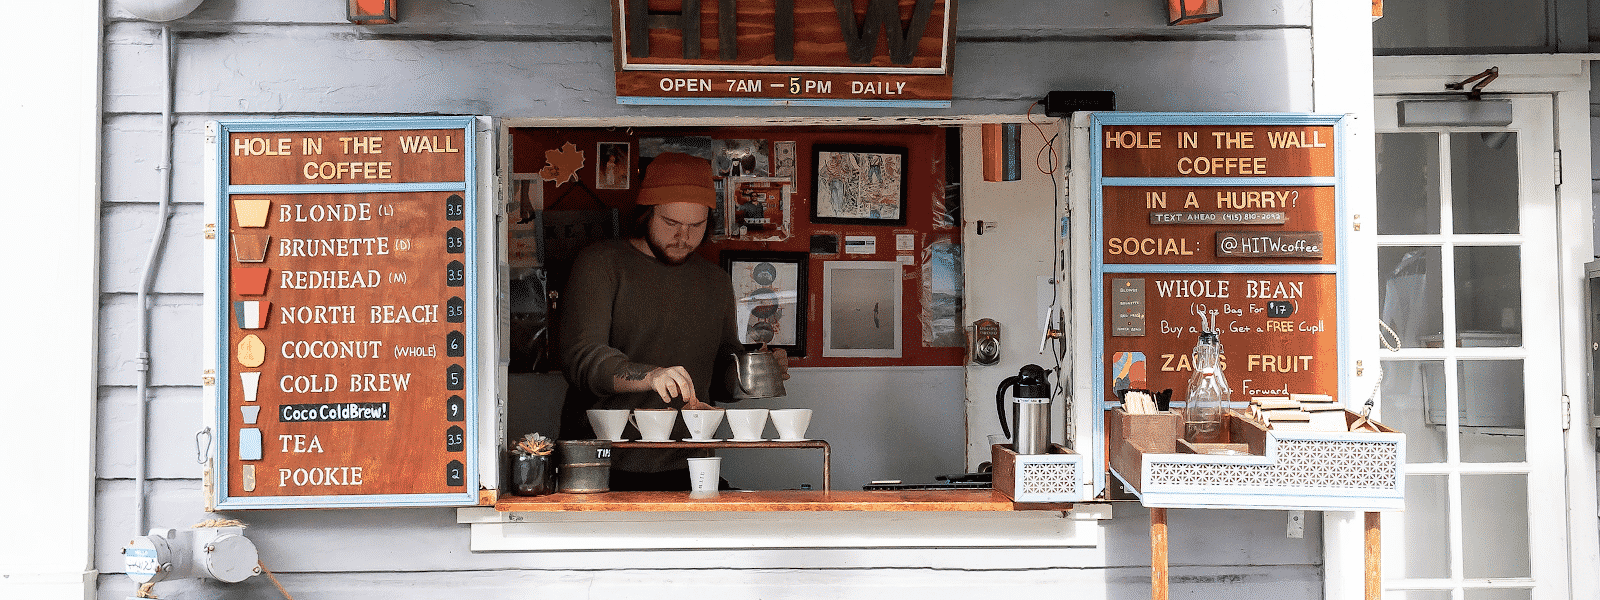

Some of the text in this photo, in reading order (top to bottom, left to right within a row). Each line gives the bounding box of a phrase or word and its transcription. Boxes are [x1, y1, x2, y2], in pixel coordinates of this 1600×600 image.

[659, 77, 712, 93] OPEN
[726, 79, 762, 93] 7AM
[851, 81, 907, 95] DAILY
[234, 135, 459, 156] HOLE IN THE WALL
[1105, 130, 1327, 149] HOLE IN THE WALL
[303, 161, 392, 180] COFFEE
[1177, 156, 1267, 175] COFFEE
[1146, 190, 1299, 209] IN A HURRY?
[279, 203, 394, 222] BLONDE (L)
[447, 203, 462, 216] 3.5
[1155, 213, 1182, 222] TEXT
[1187, 213, 1216, 221] AHEAD
[278, 236, 411, 257] BRUNETTE (D)
[447, 236, 463, 248] 3.5
[280, 269, 407, 290] REDHEAD (M)
[447, 269, 463, 281] 3.5
[1155, 280, 1304, 299] WHOLE BEAN
[280, 304, 439, 325] NORTH BEACH
[448, 305, 463, 317] 3.5
[1223, 303, 1243, 317] Bag
[1249, 304, 1264, 314] For
[1160, 320, 1184, 338] Buy
[1229, 320, 1250, 333] Get
[1266, 321, 1294, 333] FREE
[281, 340, 437, 359] COCONUT (WHOLE)
[450, 338, 458, 350] 6
[1247, 354, 1314, 373] FRUIT
[280, 373, 411, 394] COLD BREW
[451, 373, 459, 385] 5
[1242, 380, 1290, 396] Forward
[283, 405, 317, 421] Coco
[451, 404, 458, 417] 9
[279, 434, 324, 453] TEA
[447, 434, 462, 445] 3.5
[279, 466, 363, 487] POOKIE
[451, 469, 460, 480] 2
